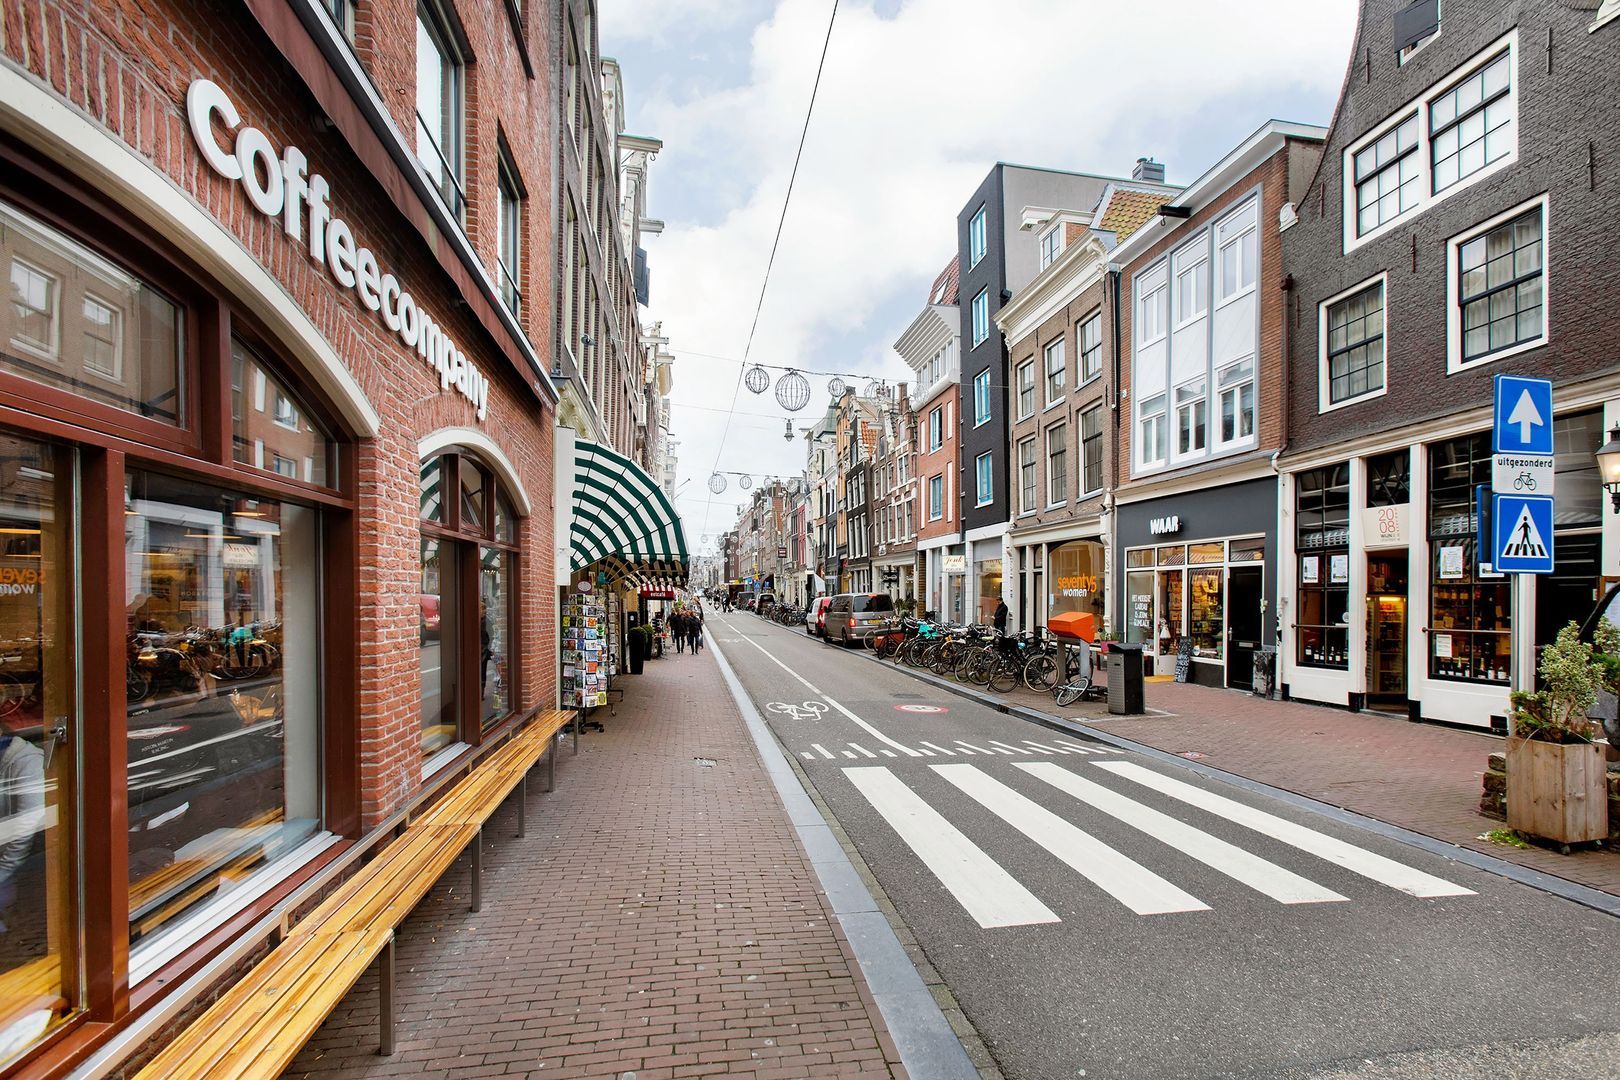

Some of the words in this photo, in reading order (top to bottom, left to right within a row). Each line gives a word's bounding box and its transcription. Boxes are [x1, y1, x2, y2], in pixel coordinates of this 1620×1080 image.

[187, 79, 489, 421] coffeecompany
[1498, 457, 1553, 469] uitgezonderd
[1378, 508, 1394, 521] 20
[1150, 515, 1179, 535] WAAR
[1379, 520, 1396, 534] 08
[1057, 573, 1097, 593] seventy5
[1062, 588, 1088, 597] women
